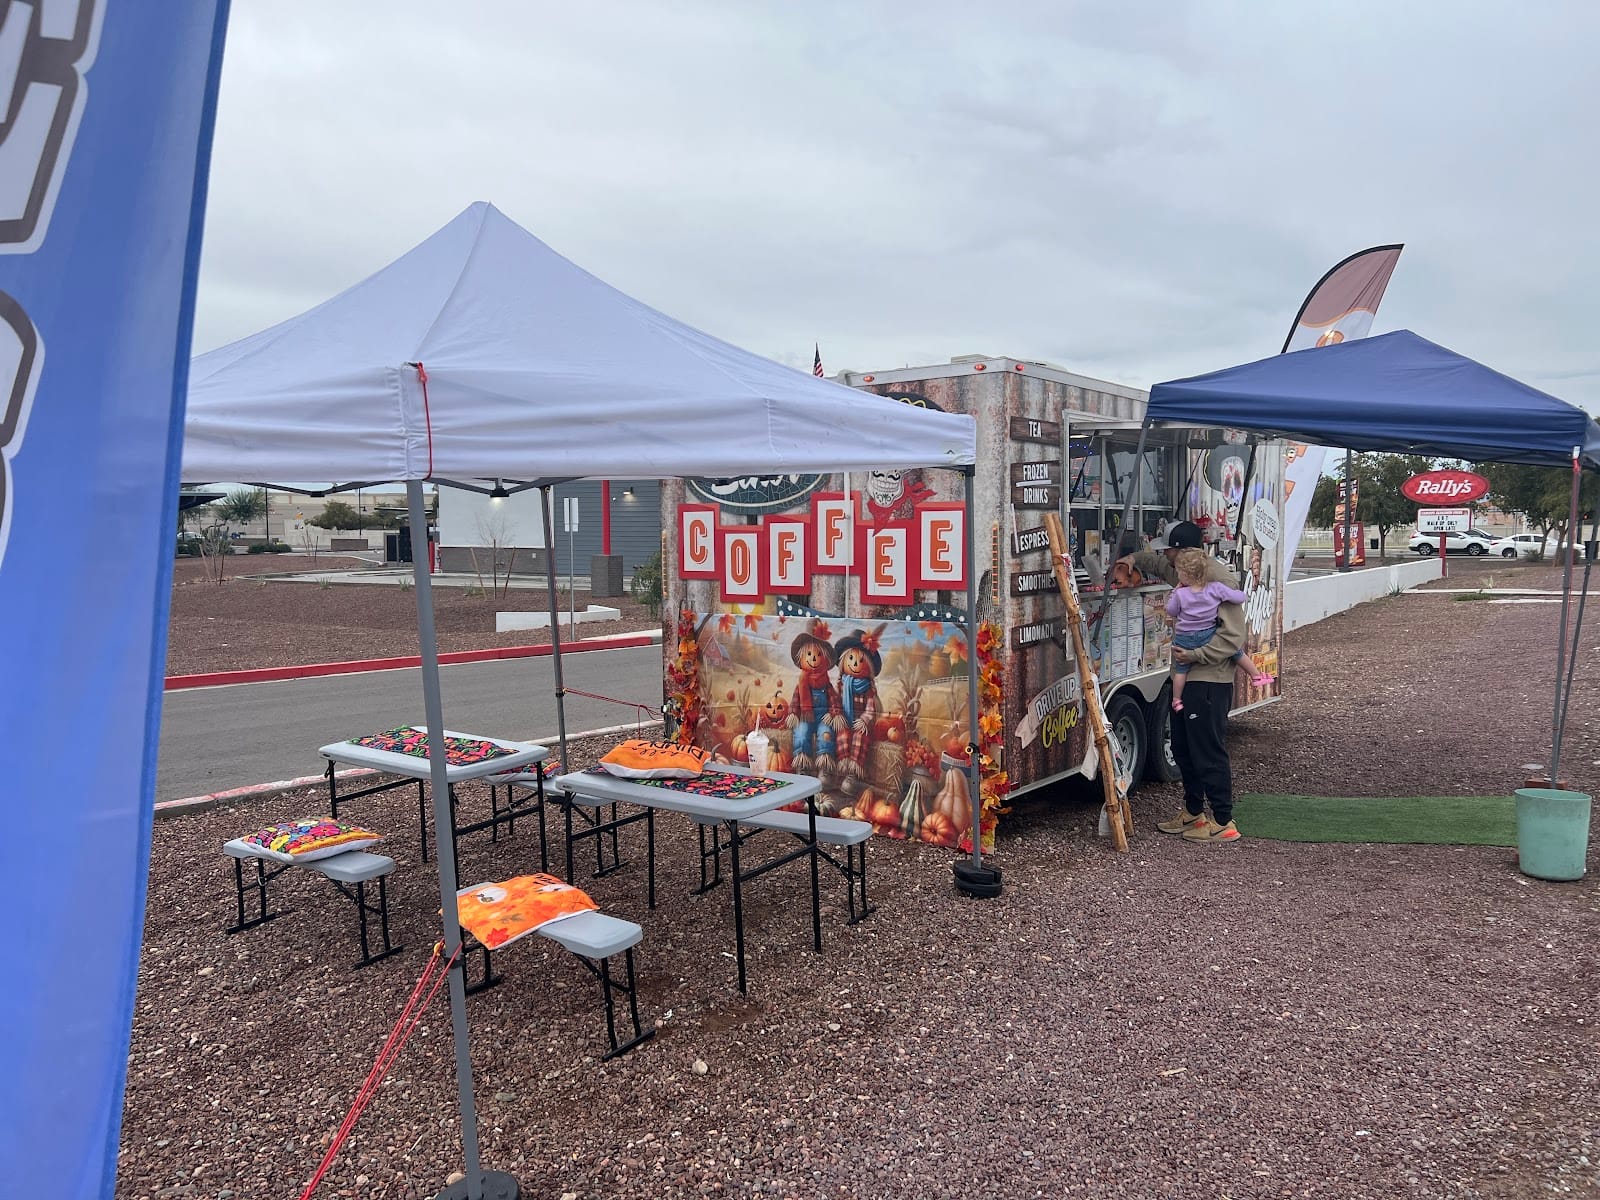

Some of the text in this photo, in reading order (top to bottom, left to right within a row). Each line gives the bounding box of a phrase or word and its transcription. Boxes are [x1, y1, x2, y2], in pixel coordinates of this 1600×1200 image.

[1028, 421, 1042, 438] TEA
[1023, 463, 1049, 481] FROZEN
[1023, 487, 1049, 504] DRINKS
[1416, 479, 1473, 497] Rally's
[688, 508, 953, 587] COFFEE
[1035, 677, 1076, 721] DRIVE UP
[1042, 704, 1078, 749] Coffee
